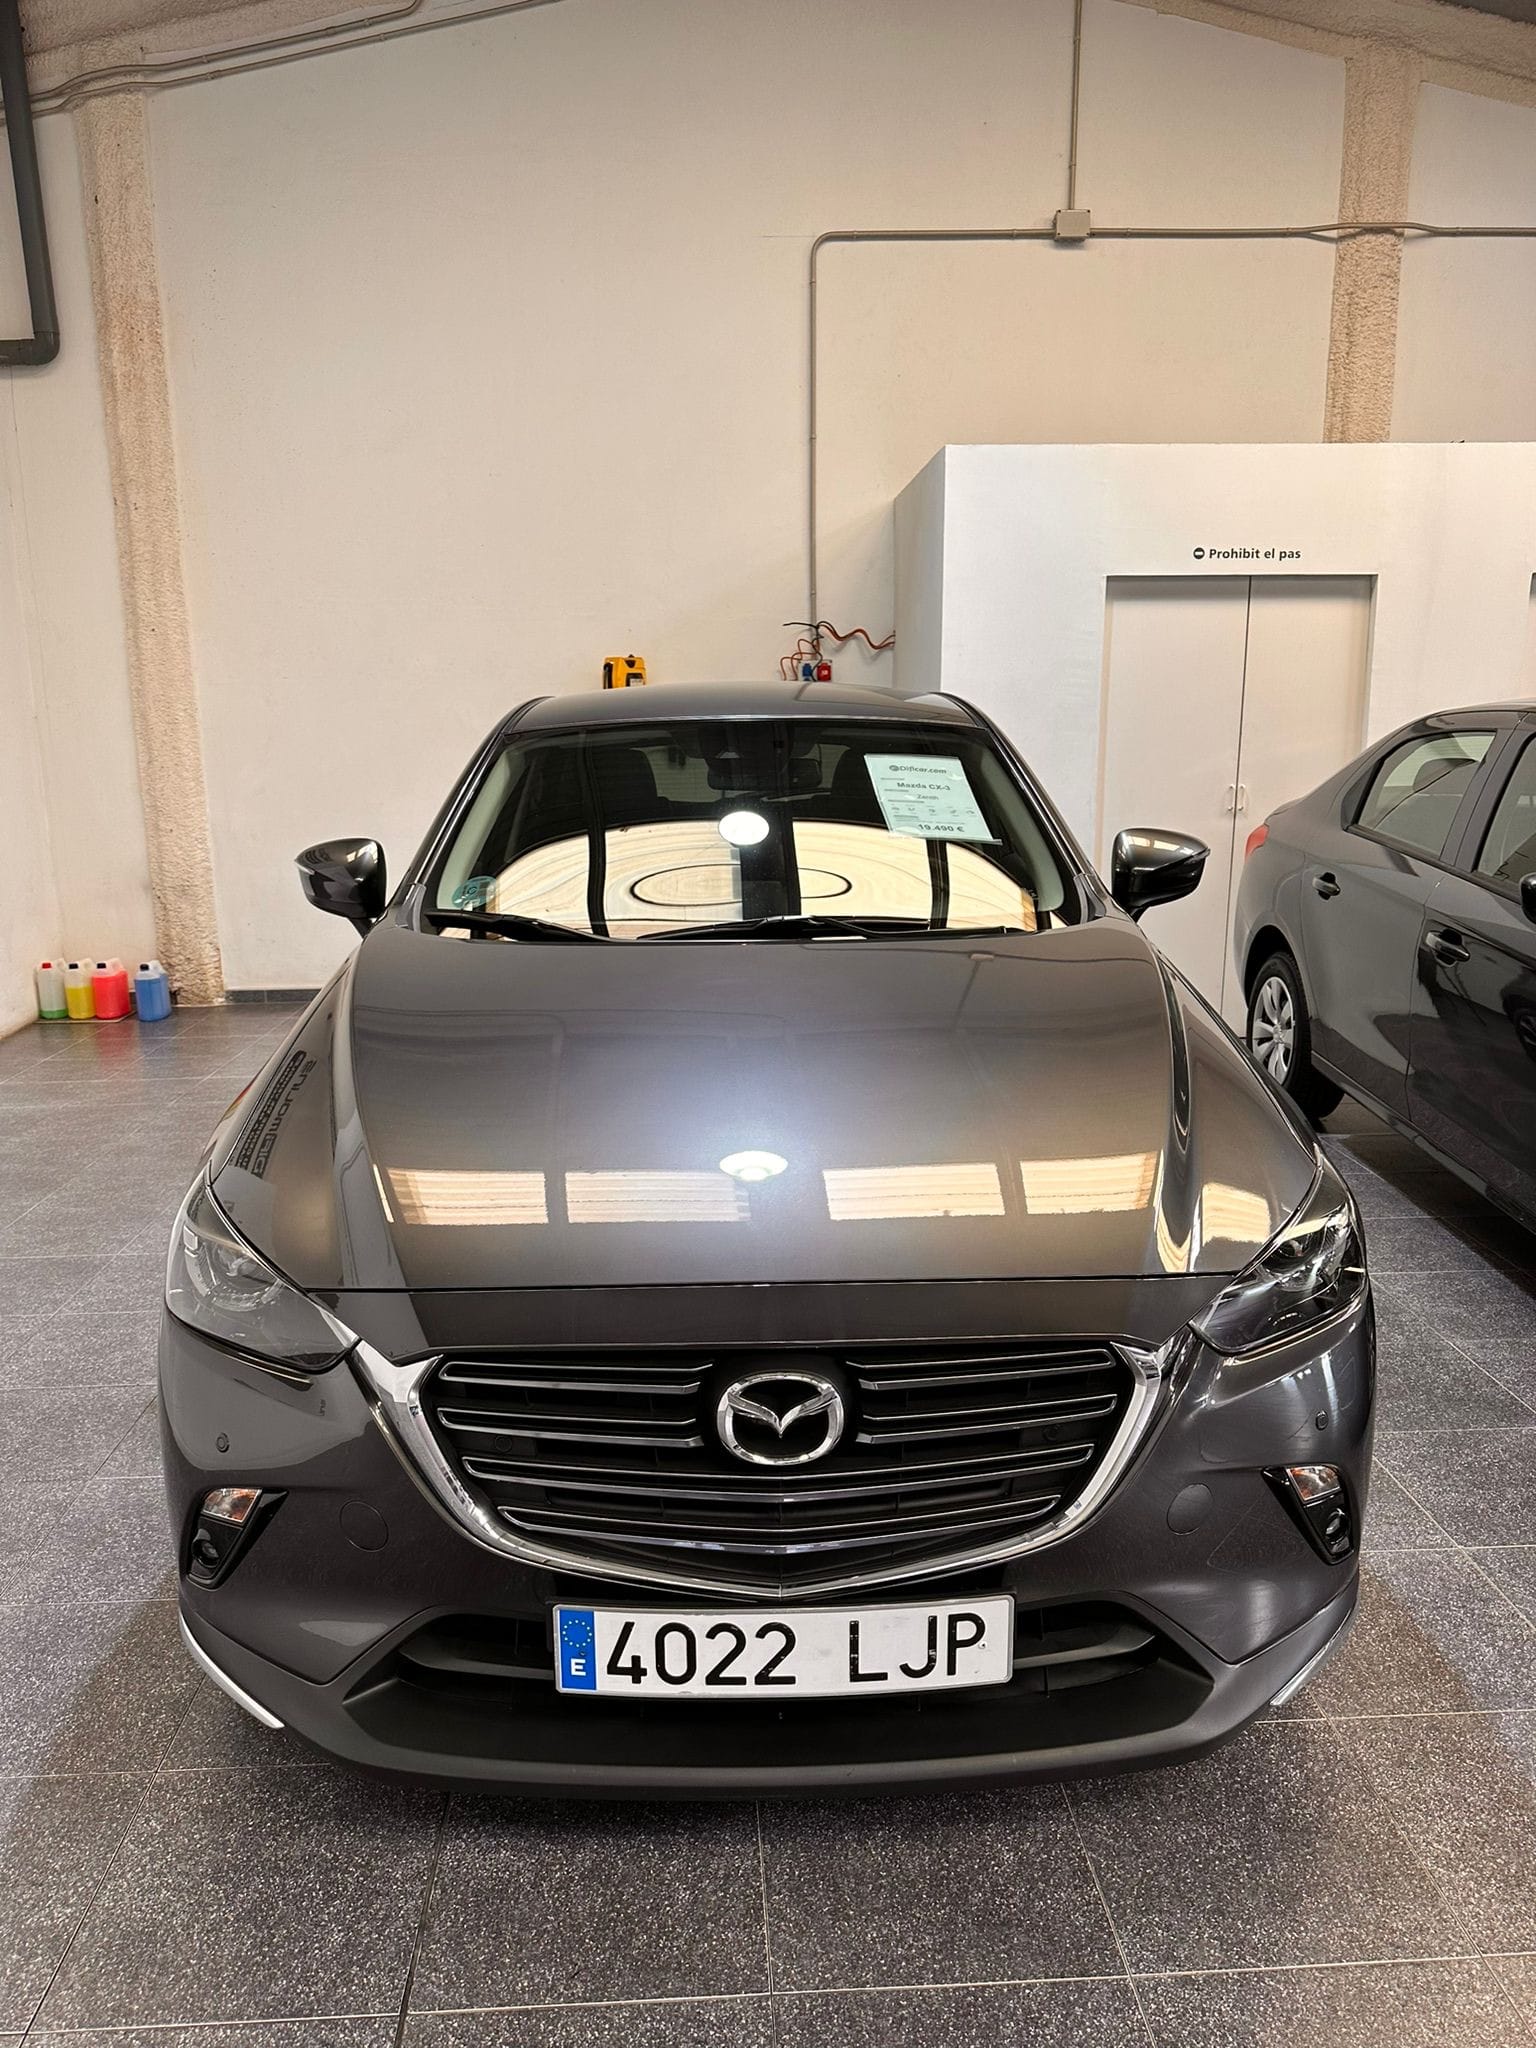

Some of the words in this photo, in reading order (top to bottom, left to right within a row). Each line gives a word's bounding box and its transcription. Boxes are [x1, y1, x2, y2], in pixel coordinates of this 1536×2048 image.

[1209, 547, 1260, 559] Prohibit
[1264, 547, 1275, 559] el
[1279, 550, 1301, 561] pas
[918, 824, 954, 832] 19.490
[606, 1621, 797, 1685] 4022
[849, 1612, 986, 1683] LJP
